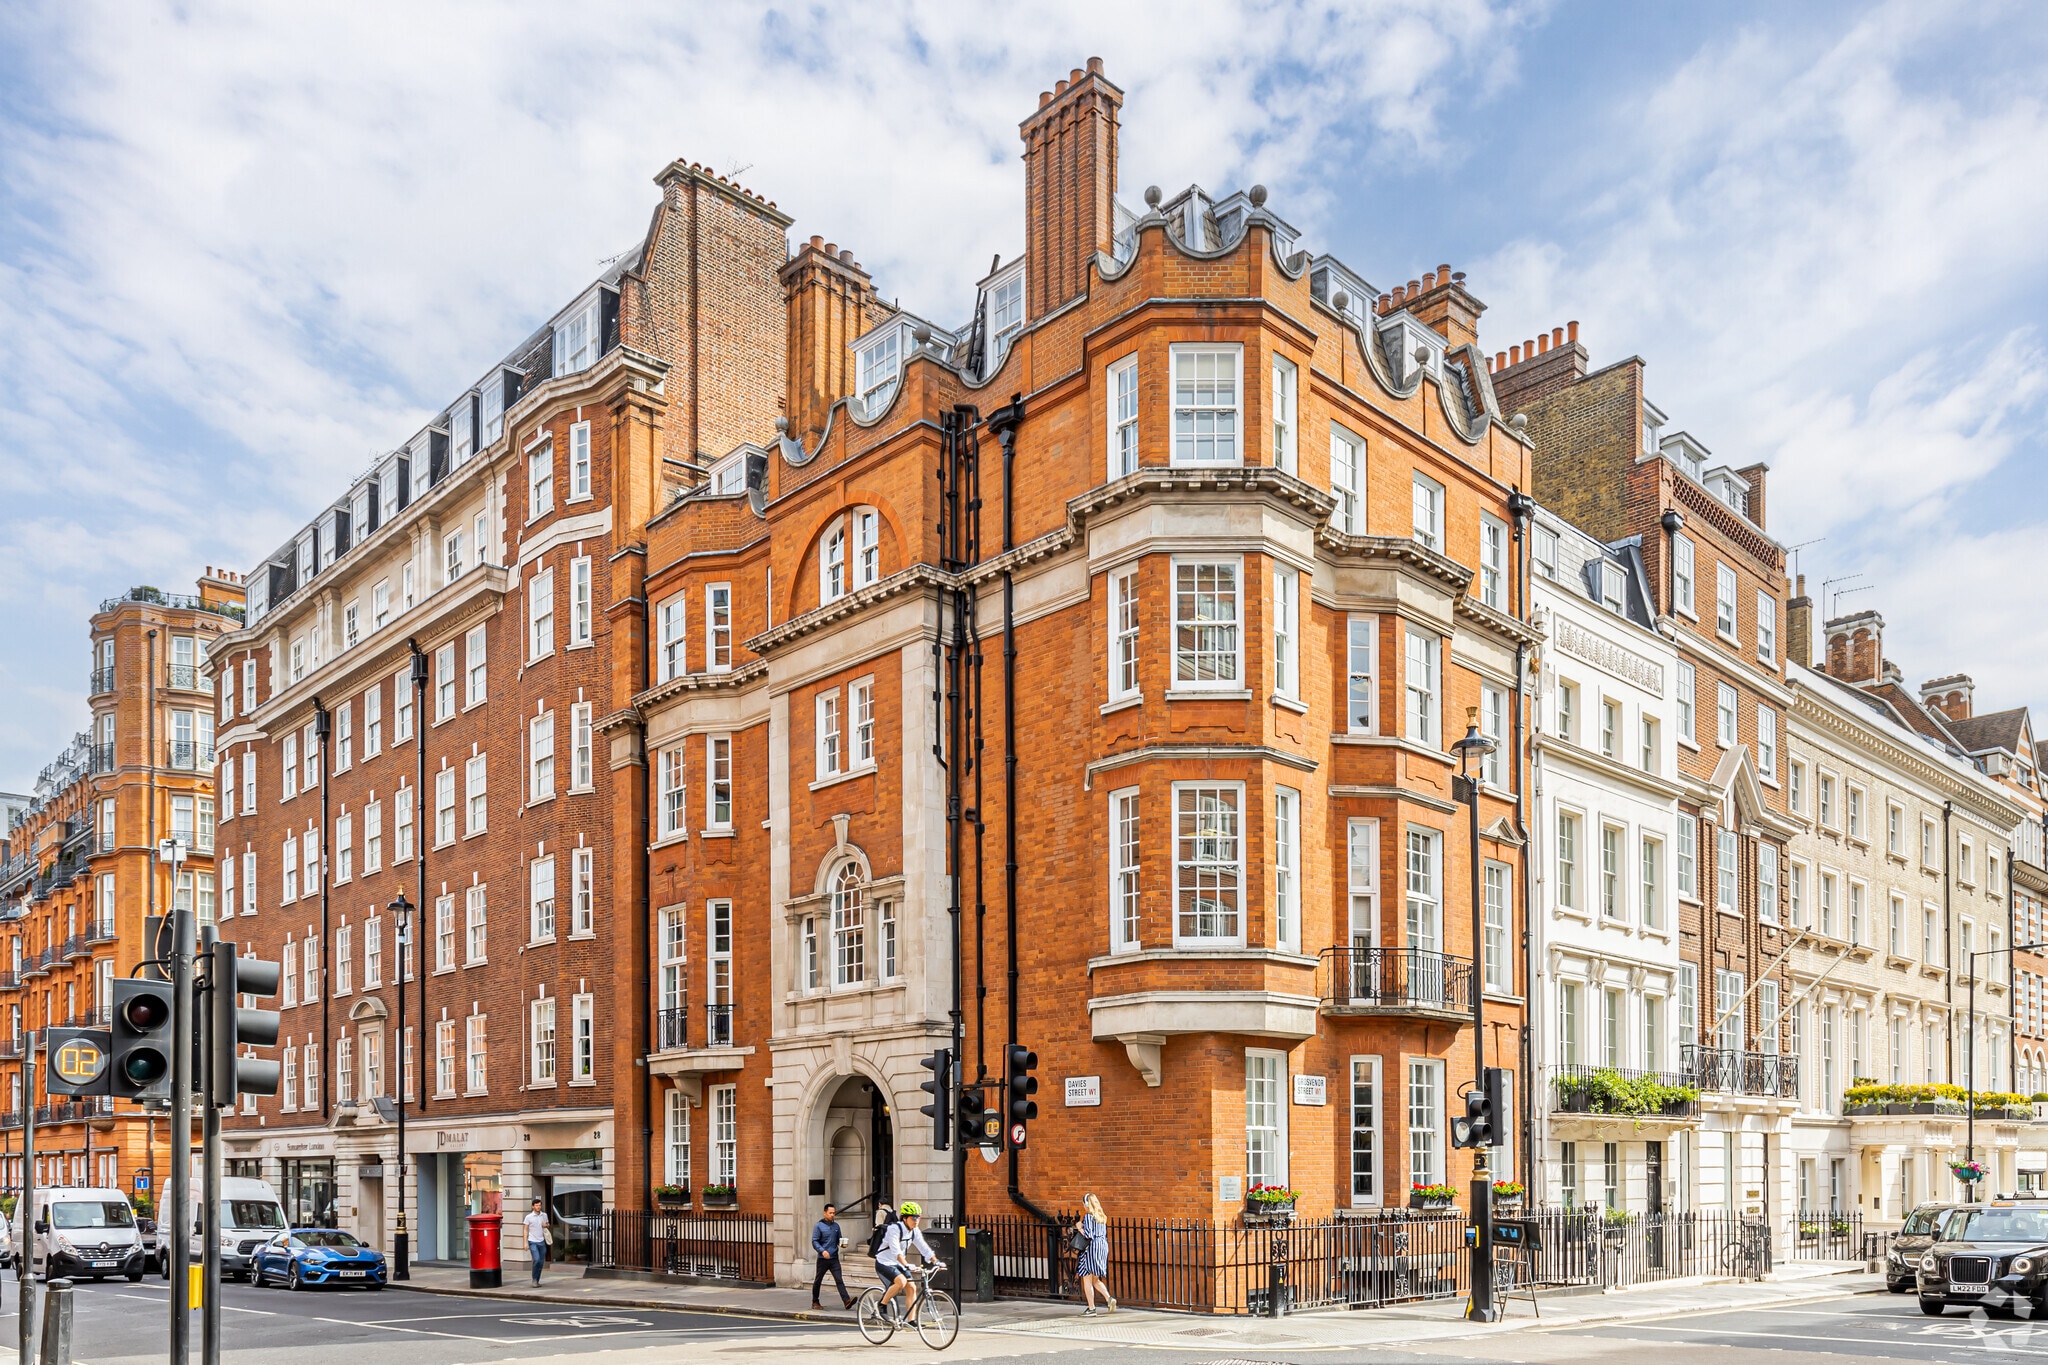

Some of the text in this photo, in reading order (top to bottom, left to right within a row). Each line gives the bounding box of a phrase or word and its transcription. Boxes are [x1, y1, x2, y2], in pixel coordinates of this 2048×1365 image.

[62, 1047, 98, 1076] 02
[1067, 1079, 1087, 1088] DAVIES
[1068, 1088, 1097, 1097] STREET W1
[1297, 1086, 1314, 1095] STREET
[523, 1133, 531, 1142] 28
[593, 1130, 601, 1140] 28
[504, 1189, 511, 1198] 30
